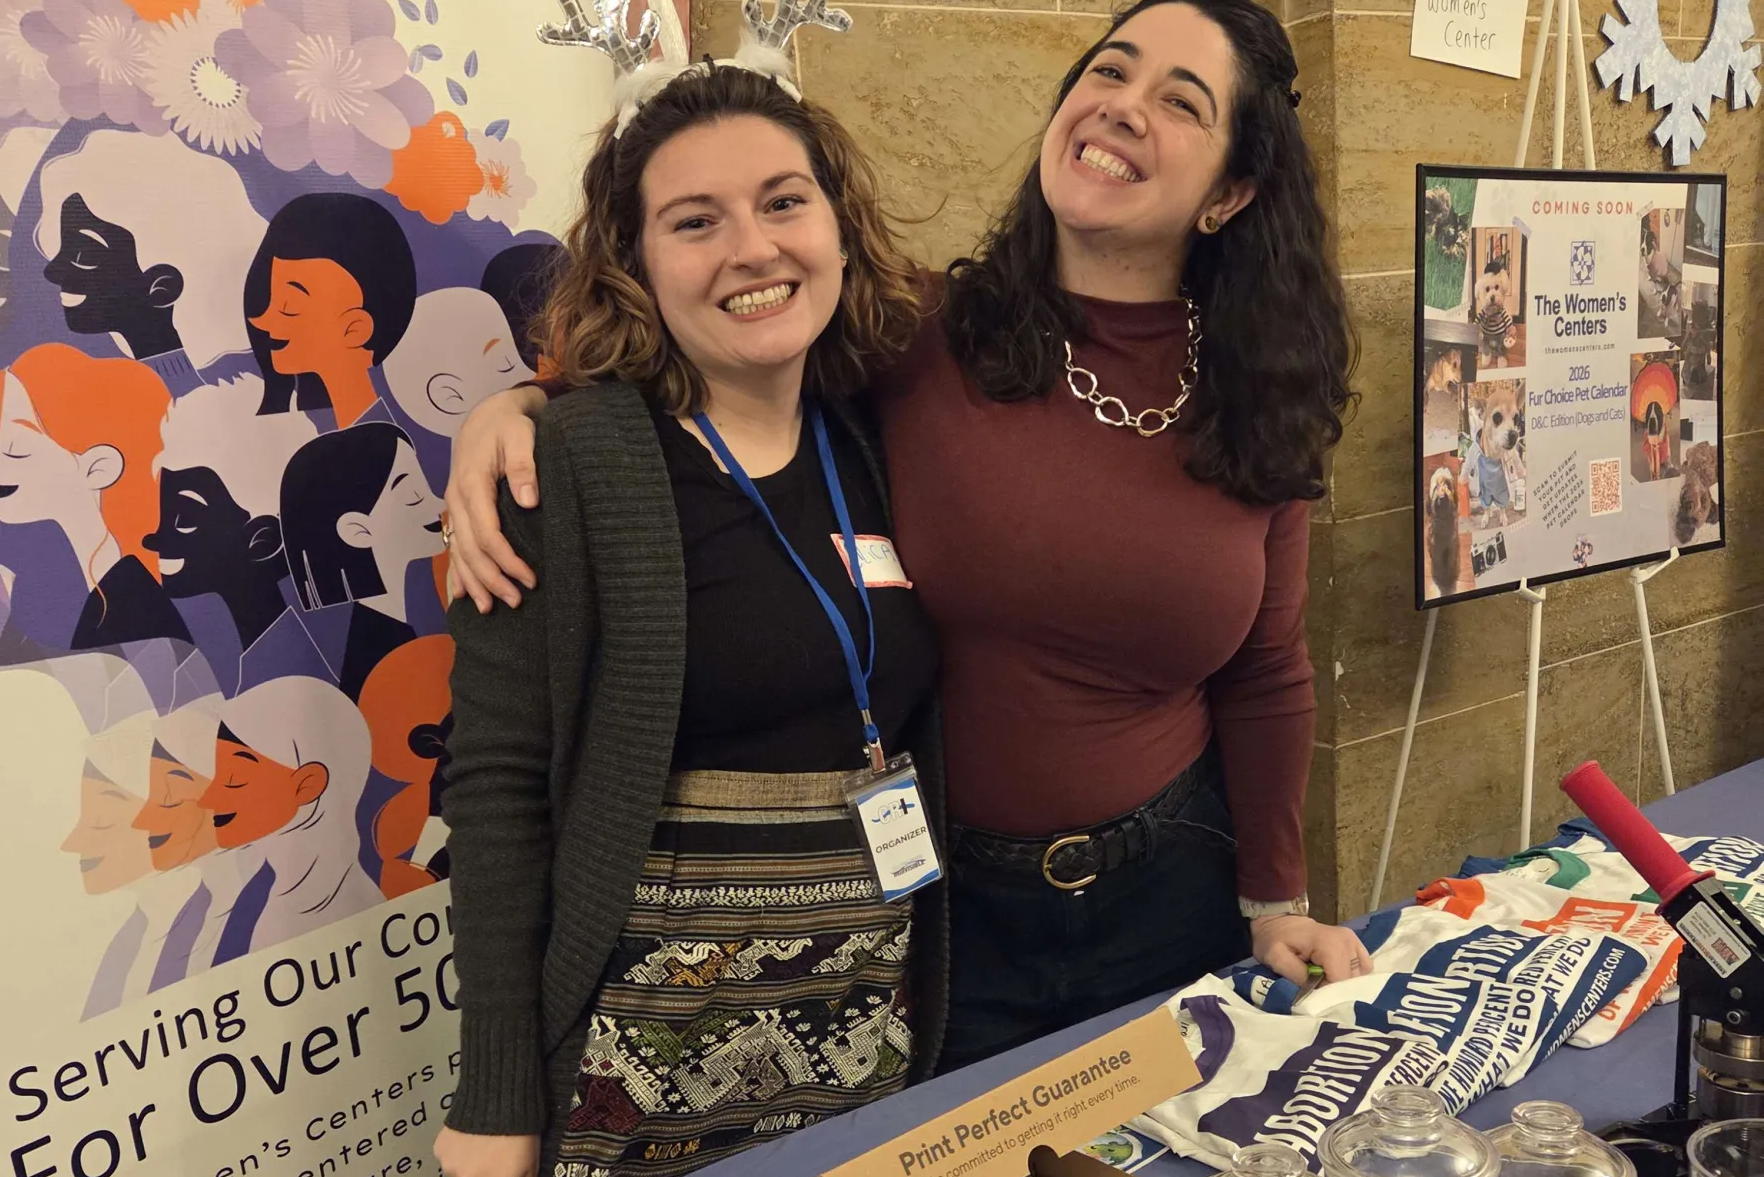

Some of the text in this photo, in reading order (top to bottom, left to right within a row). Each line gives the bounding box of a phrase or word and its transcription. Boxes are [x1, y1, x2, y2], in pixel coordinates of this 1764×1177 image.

[1427, 0, 1487, 20] Women's
[1444, 20, 1496, 50] Center
[1532, 201, 1633, 215] COMING SOON
[1534, 291, 1627, 316] The Women's
[1554, 316, 1607, 338] Centers
[1568, 365, 1590, 382] 2026
[1528, 381, 1628, 407] Fur Choice Pet Calendar
[1531, 415, 1549, 430] D&C
[1550, 413, 1575, 428] Edition
[1595, 408, 1609, 421] and
[875, 826, 927, 854] ORGANIZER
[1557, 950, 1578, 977] WE
[9, 905, 454, 1122] Serving Our Co
[1511, 988, 1536, 1023] DO
[1501, 1023, 1528, 1054] WE
[10, 1103, 155, 1177] For
[188, 1006, 370, 1124] Over
[306, 1063, 434, 1141] Centers
[898, 1049, 1131, 1176] Print Perfect Guarantee
[946, 1142, 1004, 1177] committed
[1004, 1137, 1017, 1150] to
[1017, 1118, 1055, 1146] getting
[1054, 1111, 1063, 1123] it
[1063, 1101, 1088, 1120] right
[1088, 1086, 1115, 1107] every
[1114, 1074, 1141, 1093] time.
